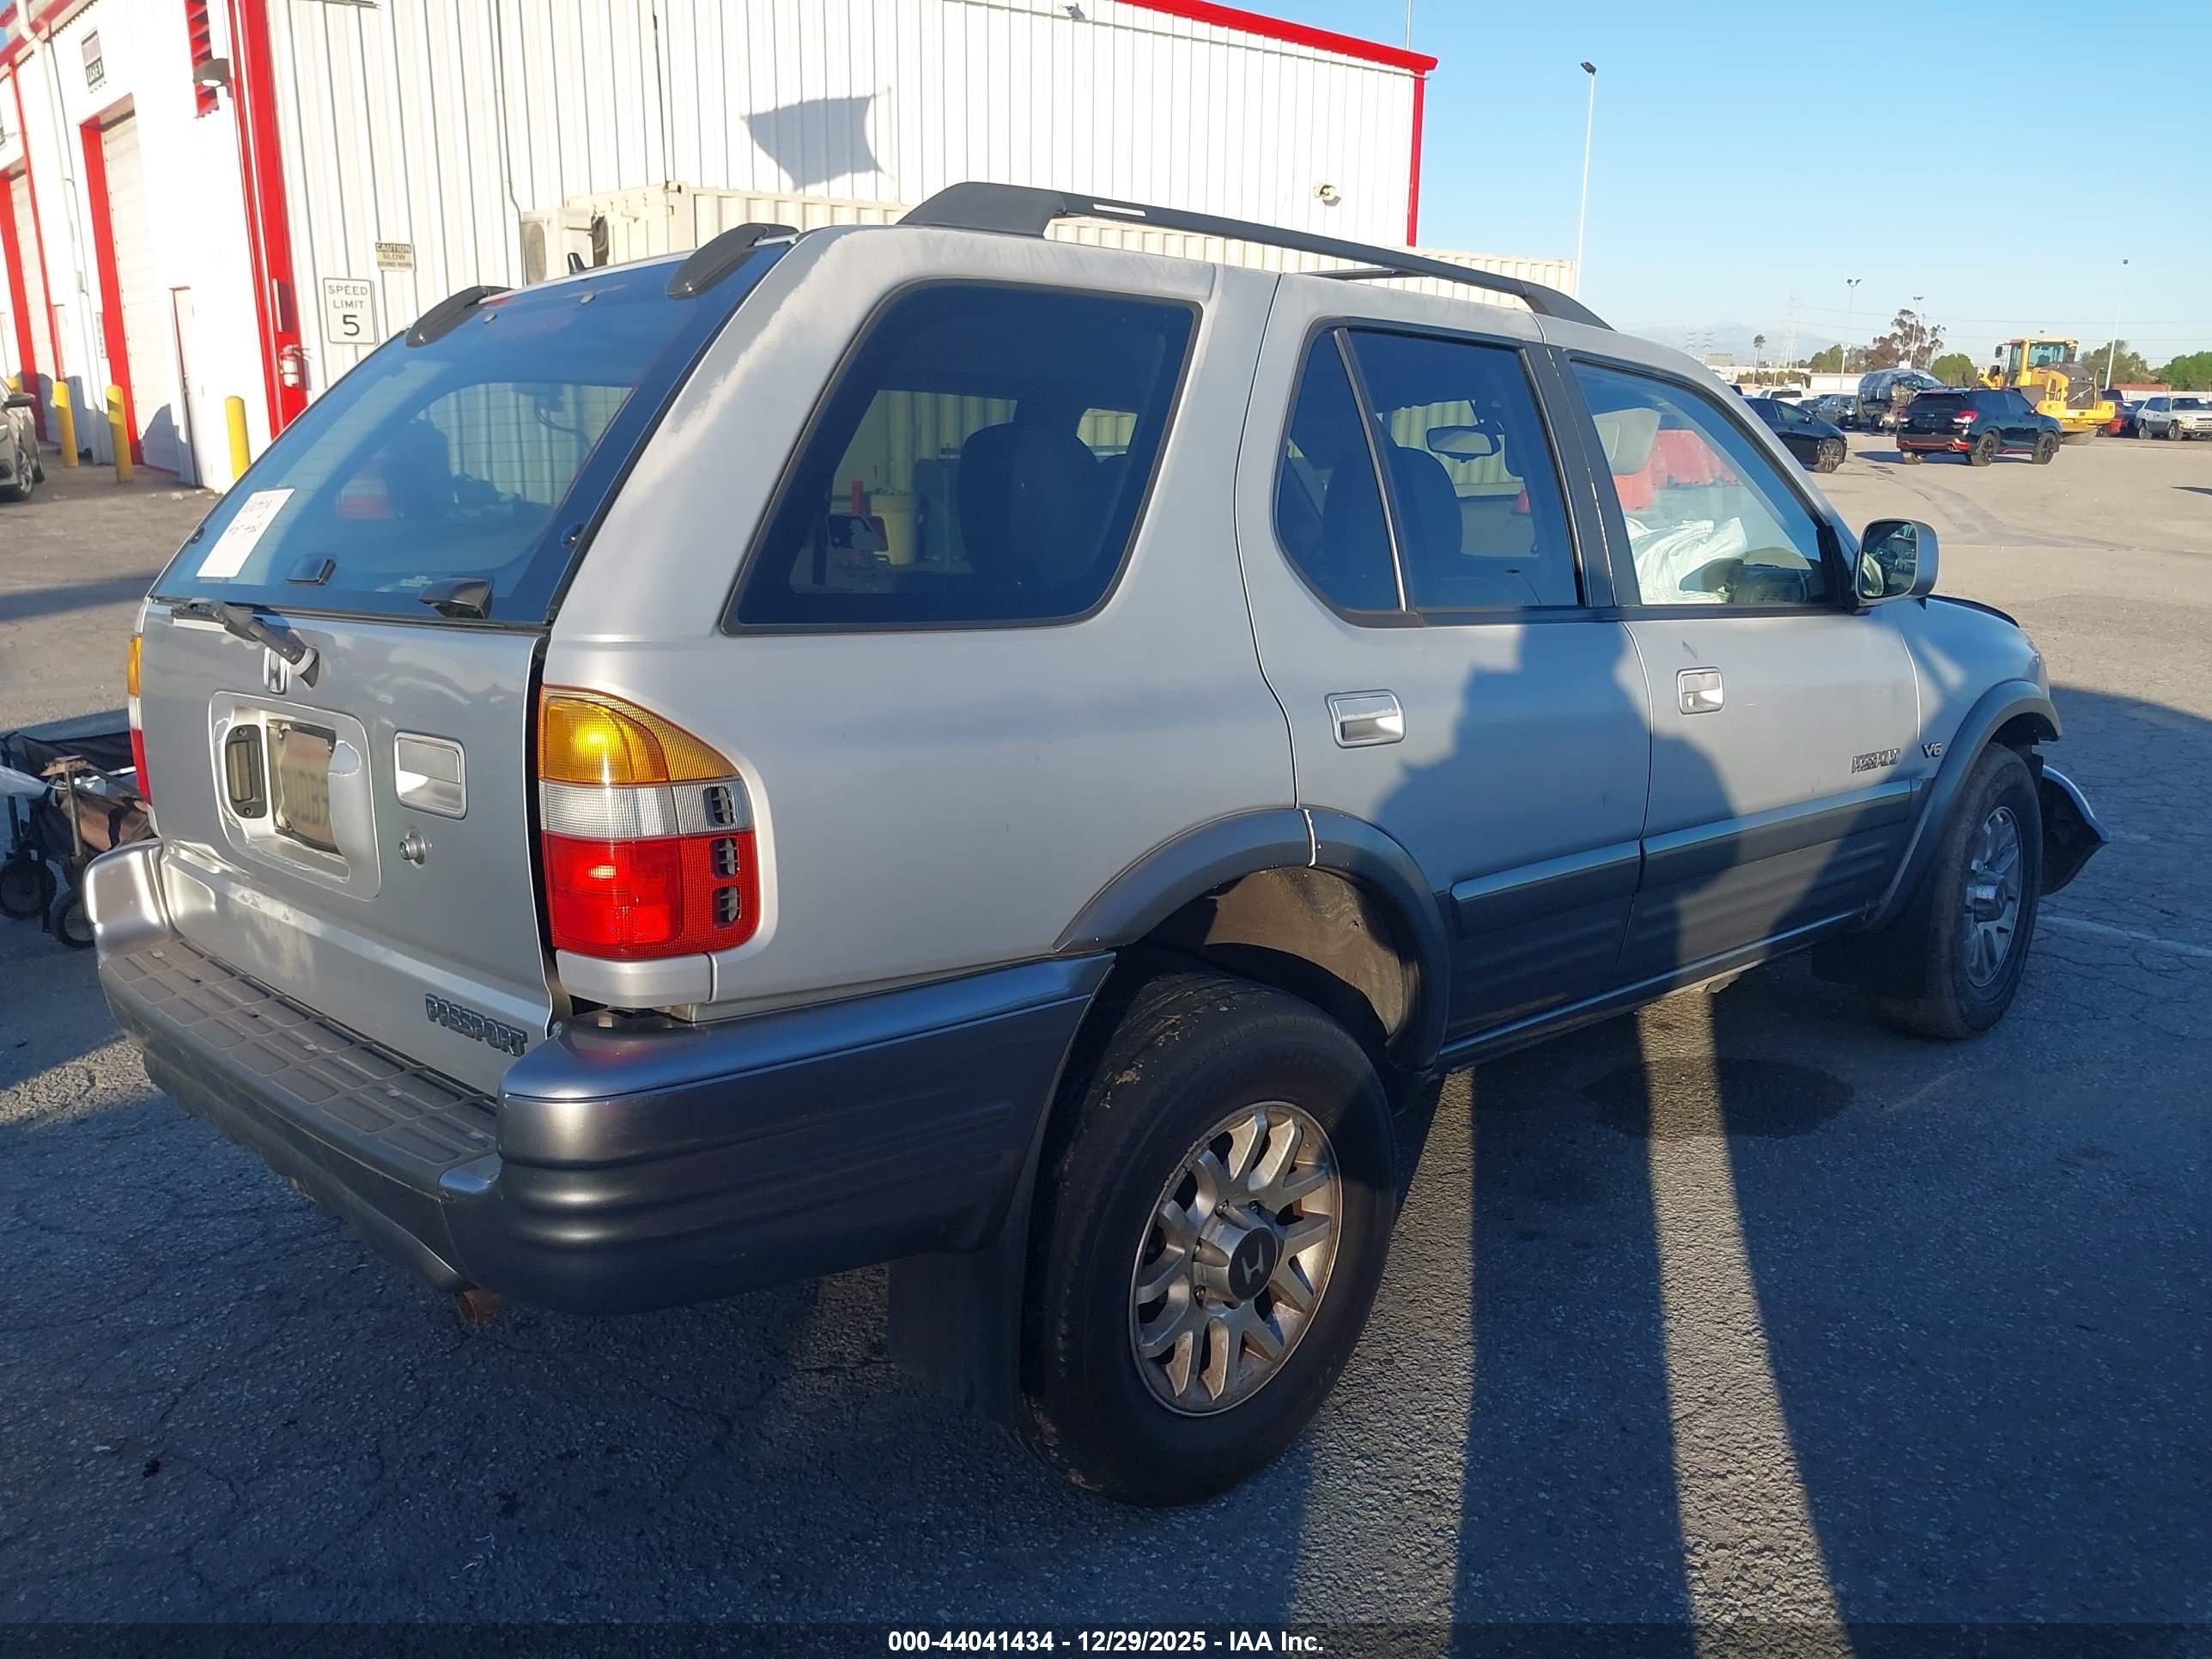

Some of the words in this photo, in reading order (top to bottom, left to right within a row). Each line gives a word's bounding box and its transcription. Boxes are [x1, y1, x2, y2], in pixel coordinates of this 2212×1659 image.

[376, 243, 412, 254] CAUTION
[382, 252, 406, 261] SLOW
[328, 284, 368, 296] SPEED
[332, 300, 364, 310] LIMIT
[342, 314, 361, 337] 5
[1922, 742, 1944, 759] V6
[425, 993, 529, 1058] PASSPORT
